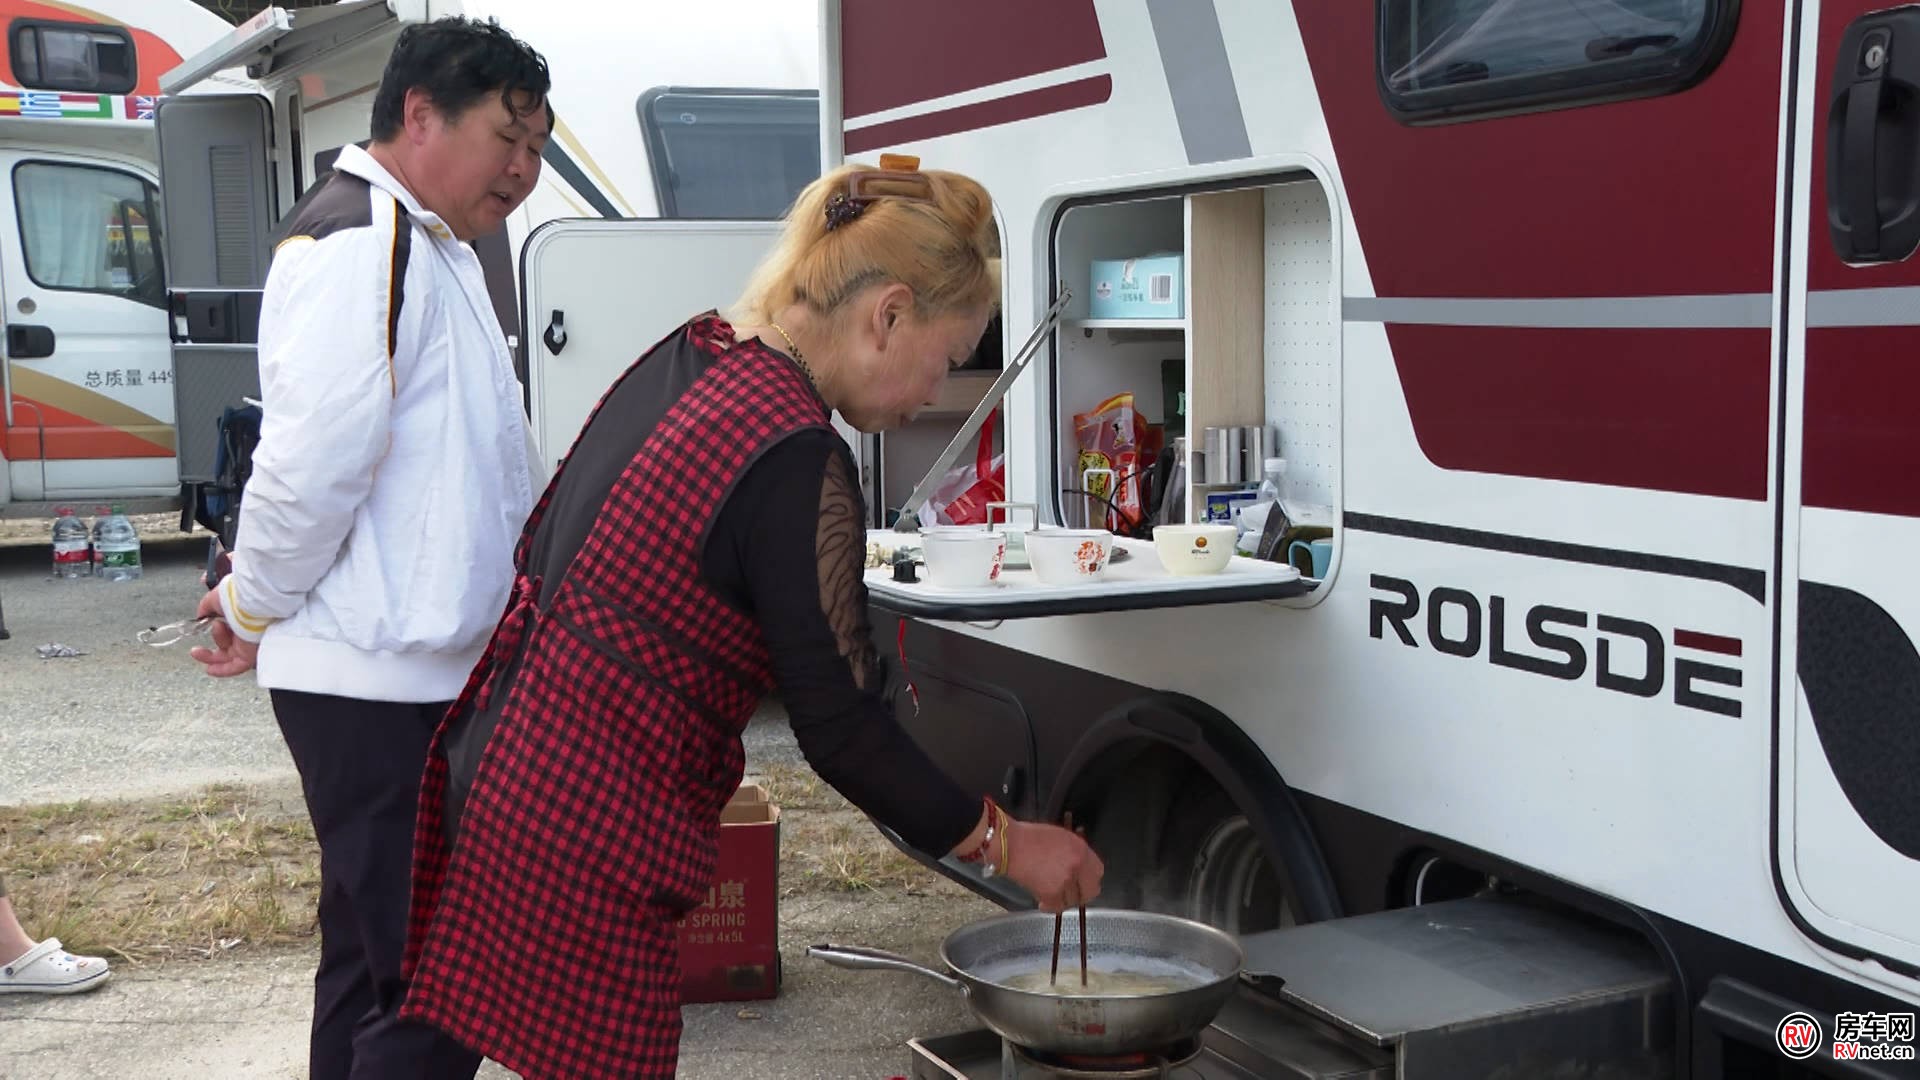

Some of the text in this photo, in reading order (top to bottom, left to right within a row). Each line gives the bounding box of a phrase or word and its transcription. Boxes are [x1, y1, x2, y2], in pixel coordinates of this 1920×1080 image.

[85, 369, 144, 387] 总质量
[1369, 573, 1743, 719] ROLSDE
[692, 912, 745, 927] SPRING
